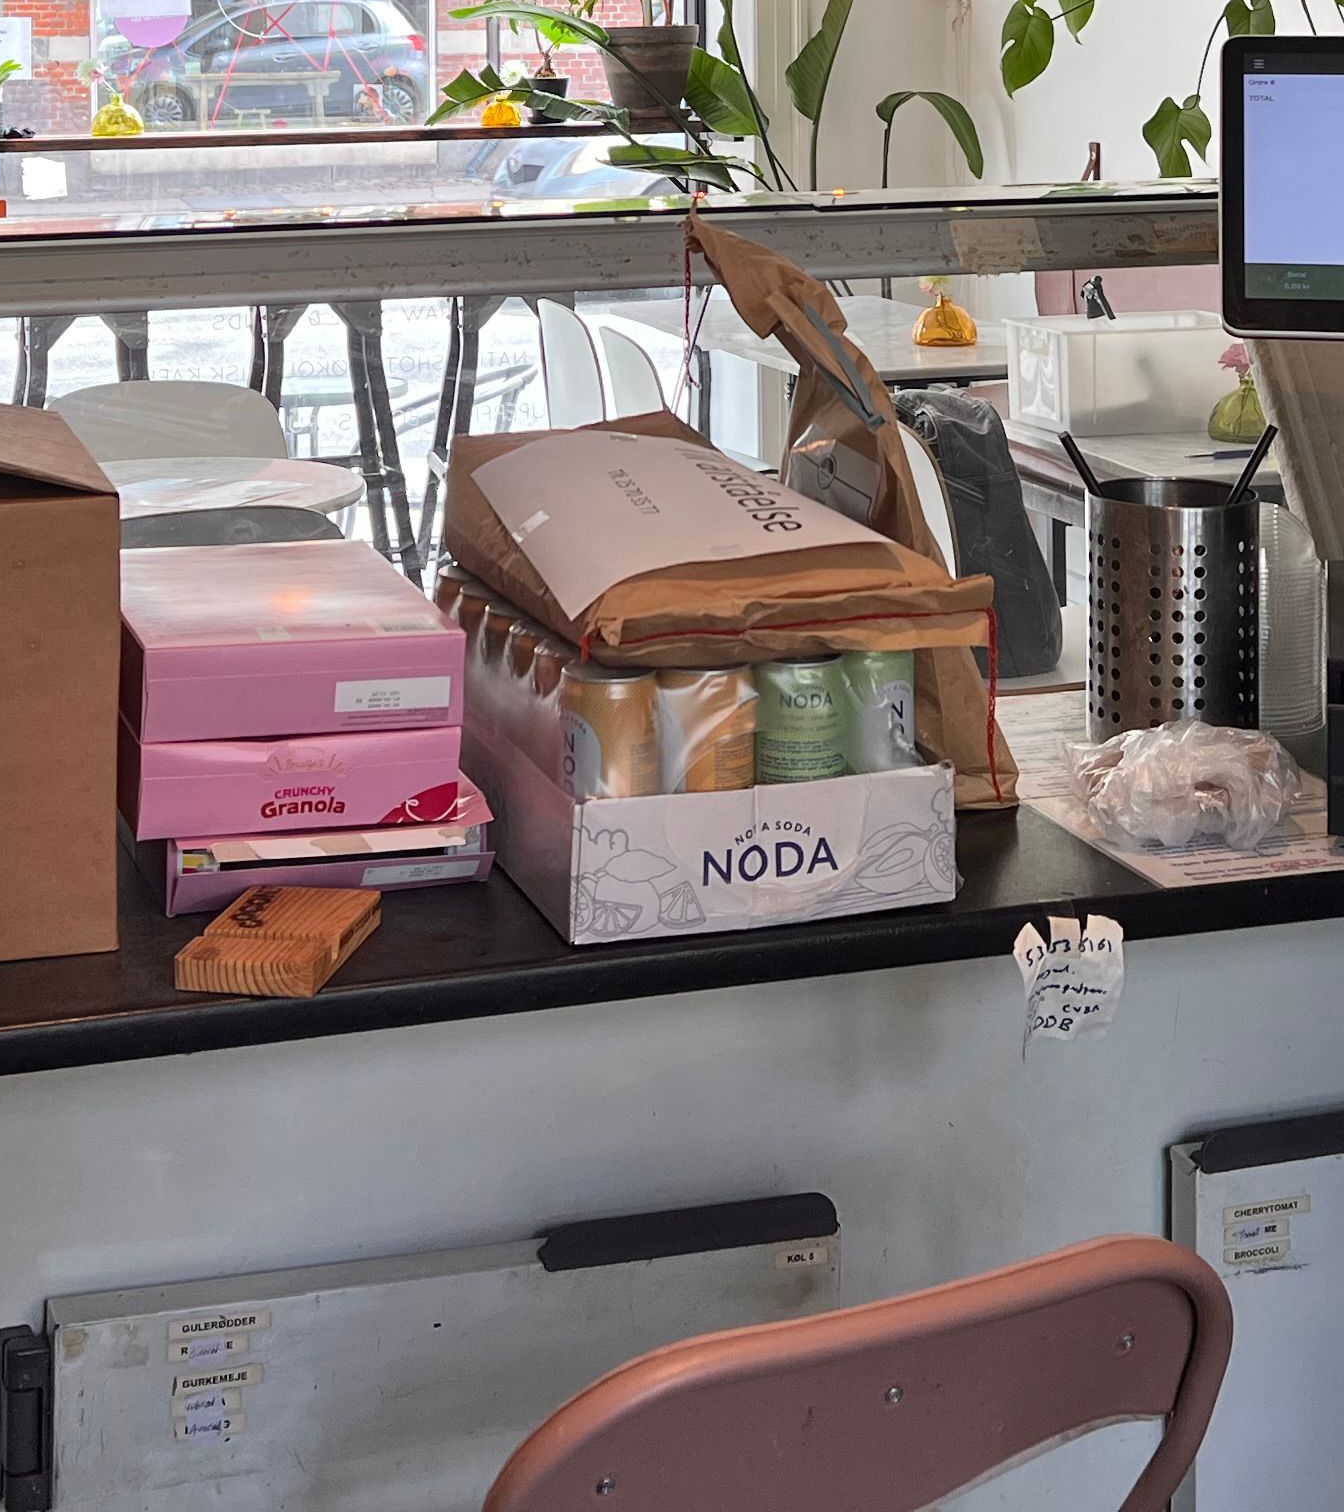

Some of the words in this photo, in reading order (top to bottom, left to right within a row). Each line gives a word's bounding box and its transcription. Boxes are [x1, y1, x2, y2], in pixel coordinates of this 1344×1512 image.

[1248, 94, 1275, 102] TOTAL
[779, 691, 834, 709] NODA
[274, 785, 336, 800] CRUNCHY
[260, 796, 346, 819] Granola
[761, 822, 770, 833] A
[775, 820, 812, 837] SODA
[703, 837, 839, 887] NODA
[1234, 1201, 1299, 1219] CHERRYTOMAT
[787, 1254, 807, 1263] KØL
[1234, 1246, 1280, 1260] BROCCOLI
[181, 1315, 257, 1334] GULERØDDER
[181, 1371, 249, 1389] GURKEMEJE
